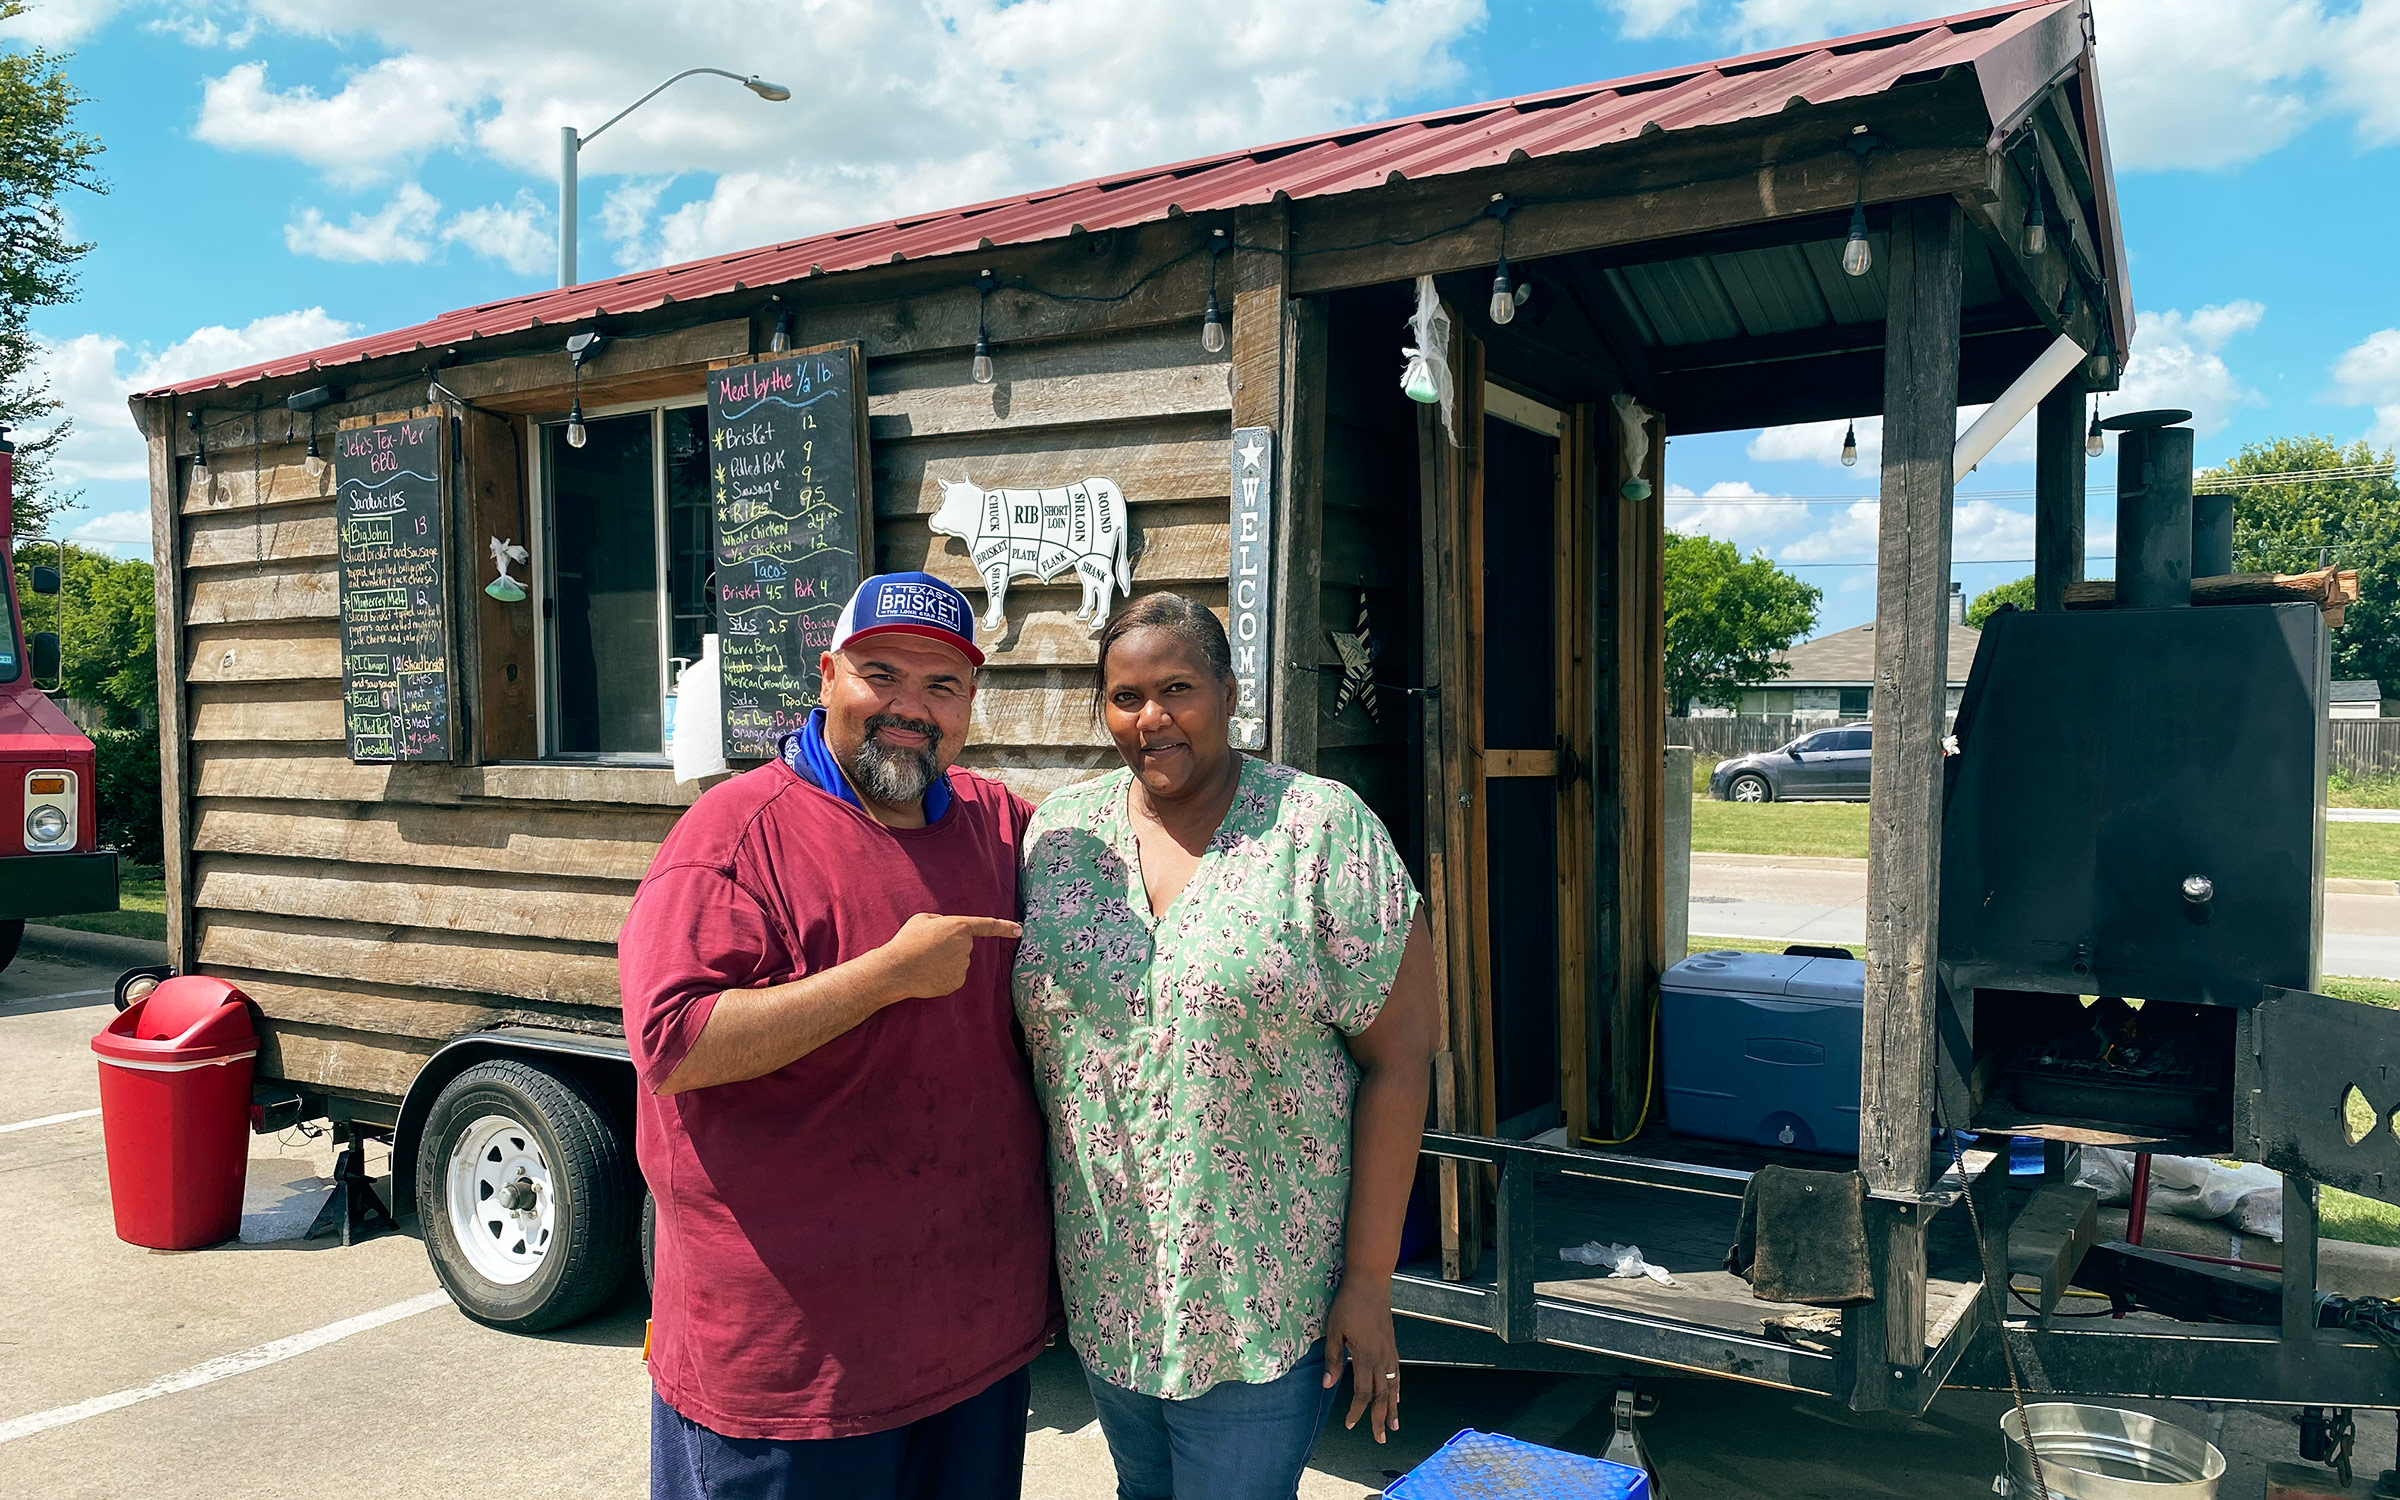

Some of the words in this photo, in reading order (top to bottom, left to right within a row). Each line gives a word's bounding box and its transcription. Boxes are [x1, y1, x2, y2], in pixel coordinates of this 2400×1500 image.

[719, 373, 751, 405] Meat
[753, 369, 770, 401] by
[771, 367, 793, 392] the
[726, 421, 775, 449] Brisket
[803, 415, 817, 430] 12
[370, 451, 398, 474] BBQ
[730, 454, 760, 478] Pulled
[763, 449, 785, 475] Pork
[803, 441, 813, 462] 9
[732, 480, 782, 503] Sausage
[801, 466, 812, 483] 9
[349, 488, 406, 511] Sandwiches
[733, 499, 769, 523] Ribs
[800, 486, 826, 511] 9.5
[1044, 505, 1068, 517] SHORT
[988, 494, 1000, 532] CHUCK
[1014, 505, 1039, 524] RIB
[1047, 518, 1066, 529] LOIN
[1074, 493, 1086, 543] SIRLOIN
[1097, 491, 1112, 534] ROUND
[414, 515, 428, 536] 13
[722, 532, 749, 547] Whole
[811, 534, 828, 549] 12
[976, 539, 1009, 565] BRISKET
[1012, 548, 1038, 562] PLATE
[1041, 550, 1068, 573] FLANK
[747, 560, 788, 577] Tacos
[1081, 561, 1107, 584] SHANK
[722, 583, 761, 601] Brisket
[765, 584, 785, 600] 4.5
[794, 578, 817, 598] Pork
[820, 580, 828, 597] 4
[901, 586, 943, 600] TEXAS
[991, 567, 1000, 598] SHANK
[1236, 477, 1260, 708] WELCOME
[881, 593, 958, 622] BRISKET
[918, 610, 936, 619] STAR
[767, 619, 789, 634] 2.5
[805, 631, 833, 648] Puddi
[778, 693, 801, 710] Topo
[800, 691, 822, 708] Chic
[393, 715, 402, 728] 8
[727, 710, 751, 727] Root
[356, 737, 395, 757] Quesadilla
